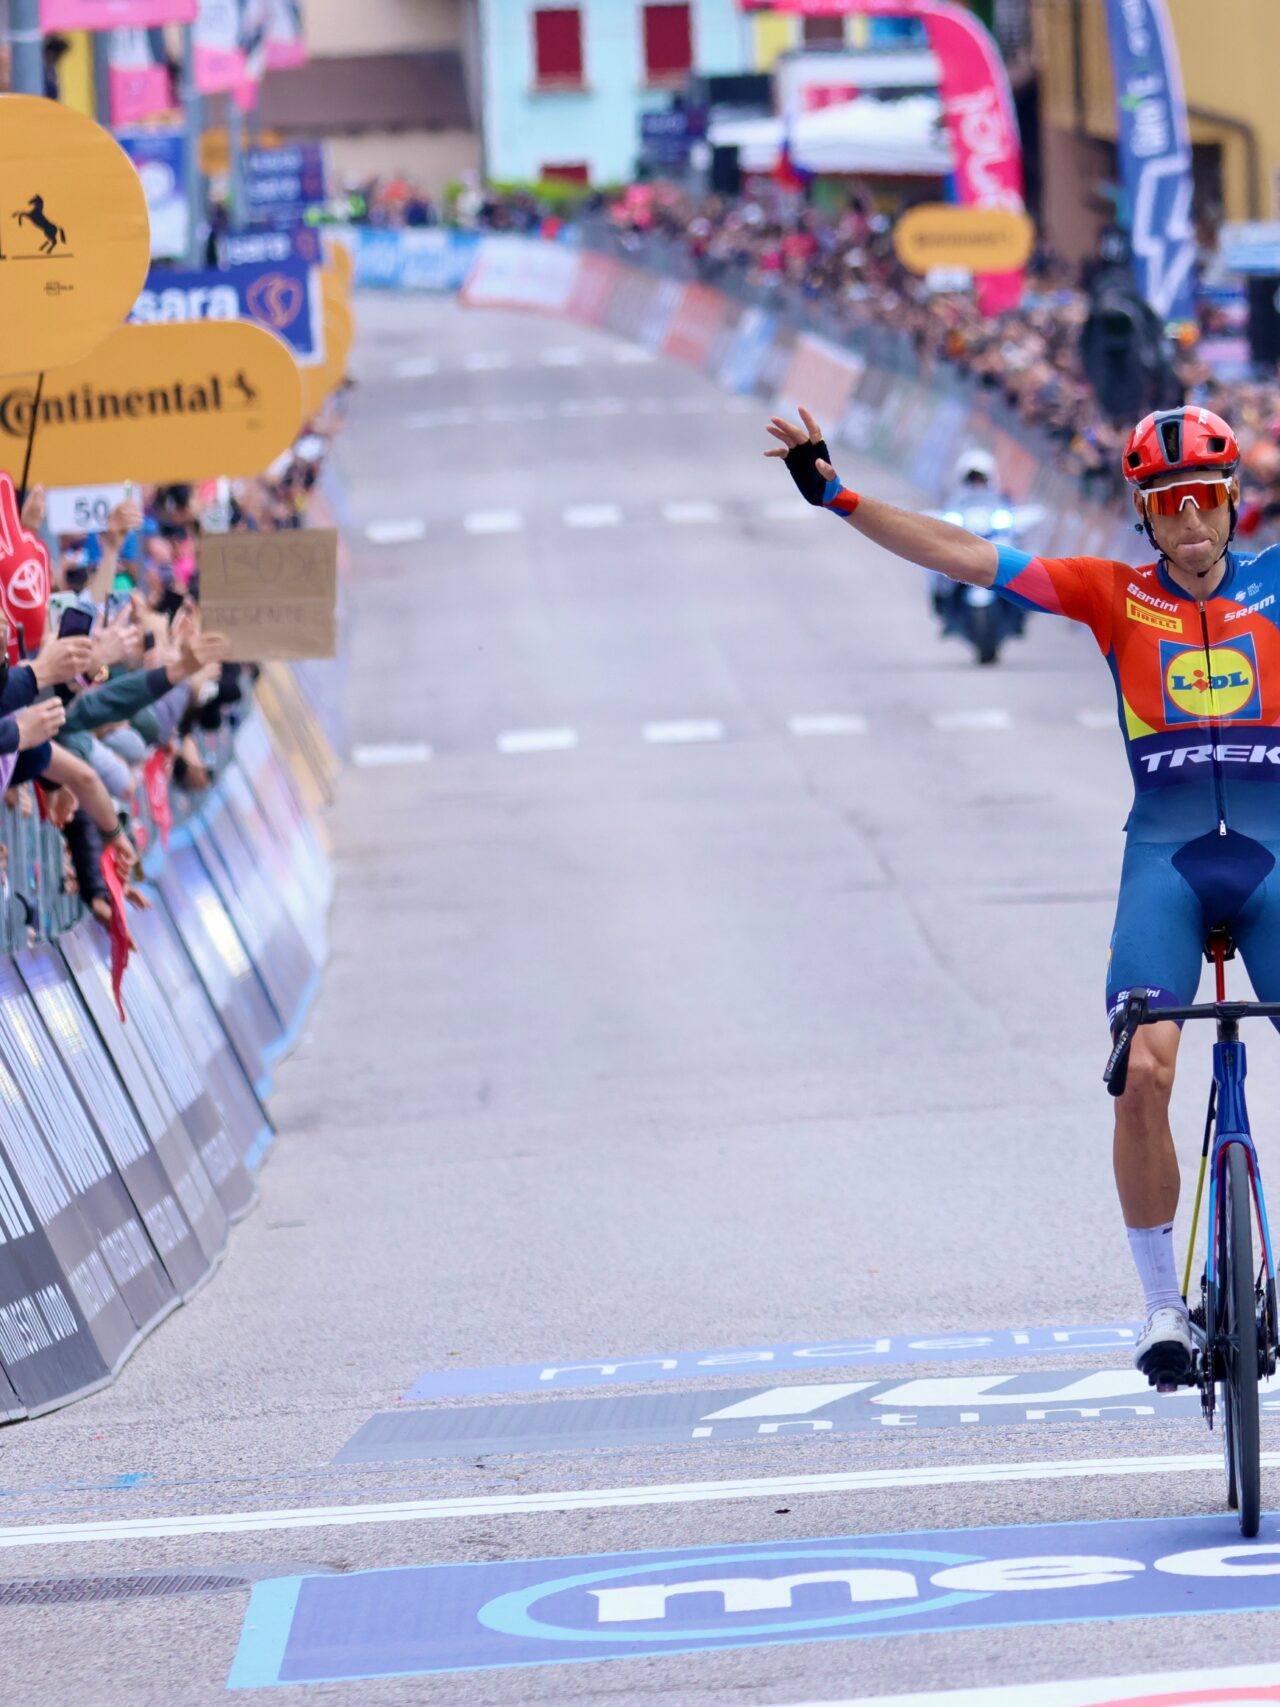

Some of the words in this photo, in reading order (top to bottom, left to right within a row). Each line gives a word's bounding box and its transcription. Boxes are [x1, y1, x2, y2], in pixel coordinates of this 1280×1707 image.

[128, 285, 240, 321] sara
[0, 374, 222, 437] Continental
[73, 496, 110, 528] 50
[1126, 582, 1179, 613] Santini
[1224, 594, 1276, 623] SRAM
[1130, 603, 1177, 630] PIRELLI
